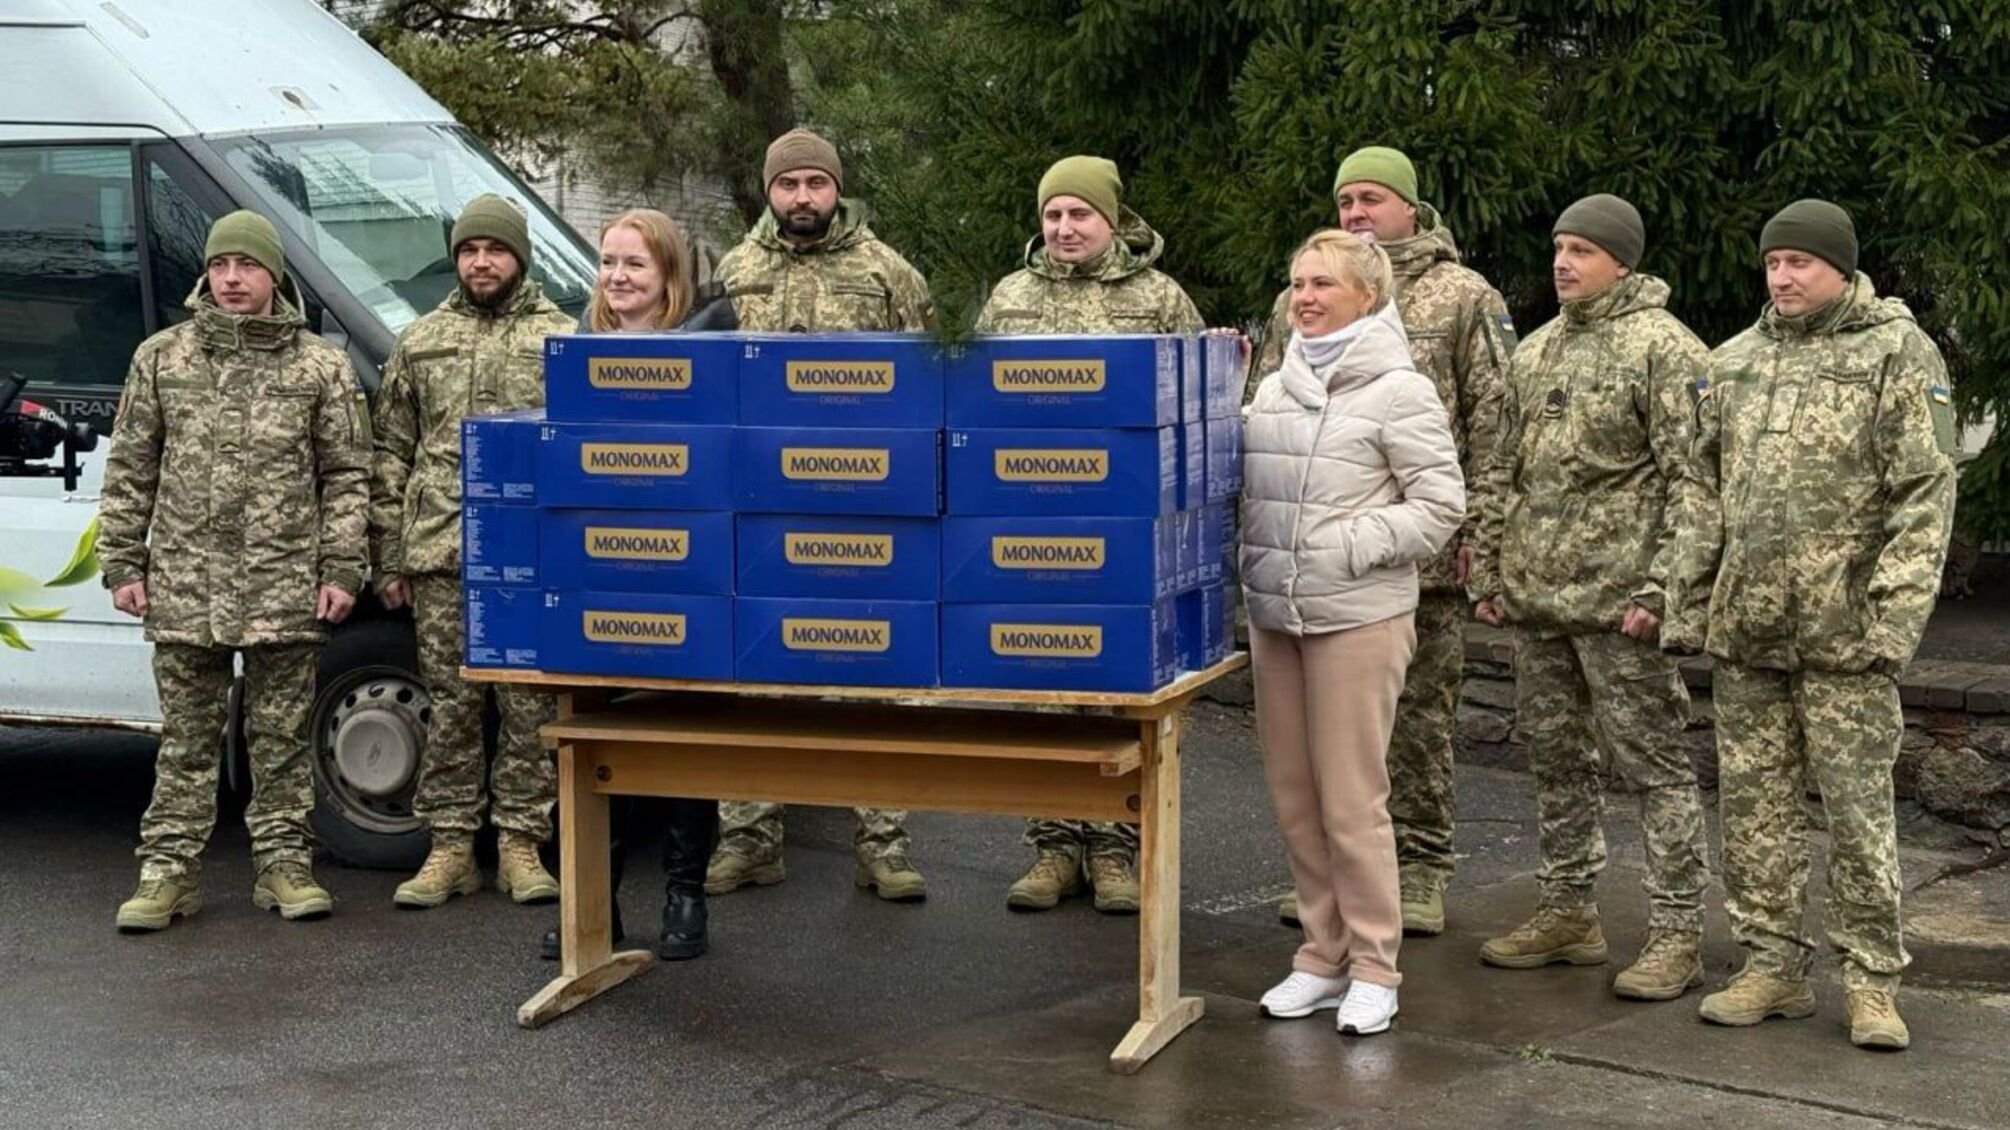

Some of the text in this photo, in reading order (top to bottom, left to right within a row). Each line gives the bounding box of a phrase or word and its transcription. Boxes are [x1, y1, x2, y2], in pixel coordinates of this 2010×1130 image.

[597, 366, 683, 382] MONOMAX
[795, 369, 886, 385] MONOMAX
[1003, 368, 1096, 384] MONOMAX
[591, 452, 680, 468] MONOMAX
[790, 457, 881, 473] MONOMAX
[1005, 457, 1099, 474] MONOMAX
[593, 536, 680, 553] MONOMAX
[794, 541, 884, 559] MONOMAX
[1002, 545, 1096, 562] MONOMAX
[592, 619, 678, 637] MONOMAX
[792, 627, 881, 644] MONOMAX
[1000, 632, 1093, 650] MONOMAX
